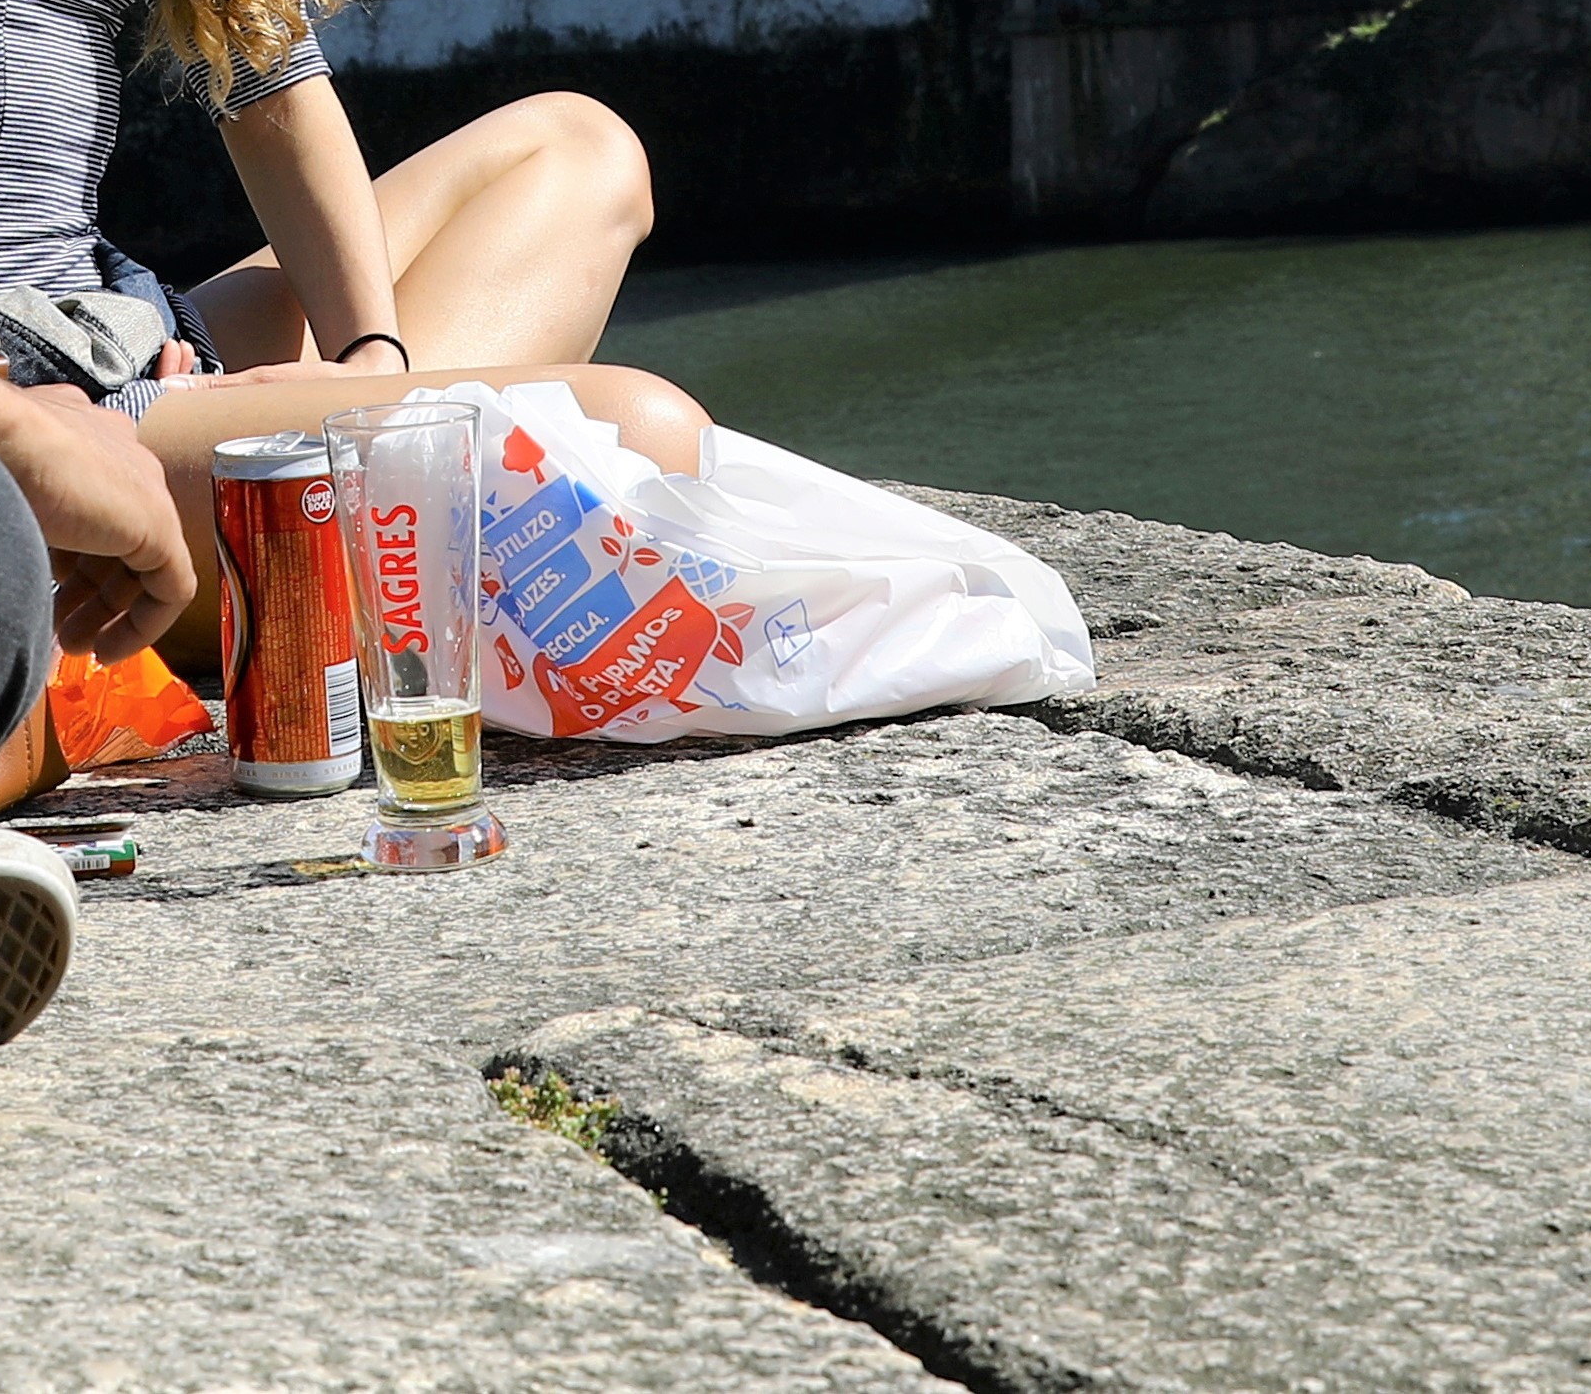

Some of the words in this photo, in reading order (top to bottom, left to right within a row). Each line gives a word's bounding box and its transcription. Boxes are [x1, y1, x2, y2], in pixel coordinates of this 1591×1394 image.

[306, 490, 331, 504] SUPER
[307, 500, 331, 512] BOCK
[371, 504, 429, 655] SAGRES
